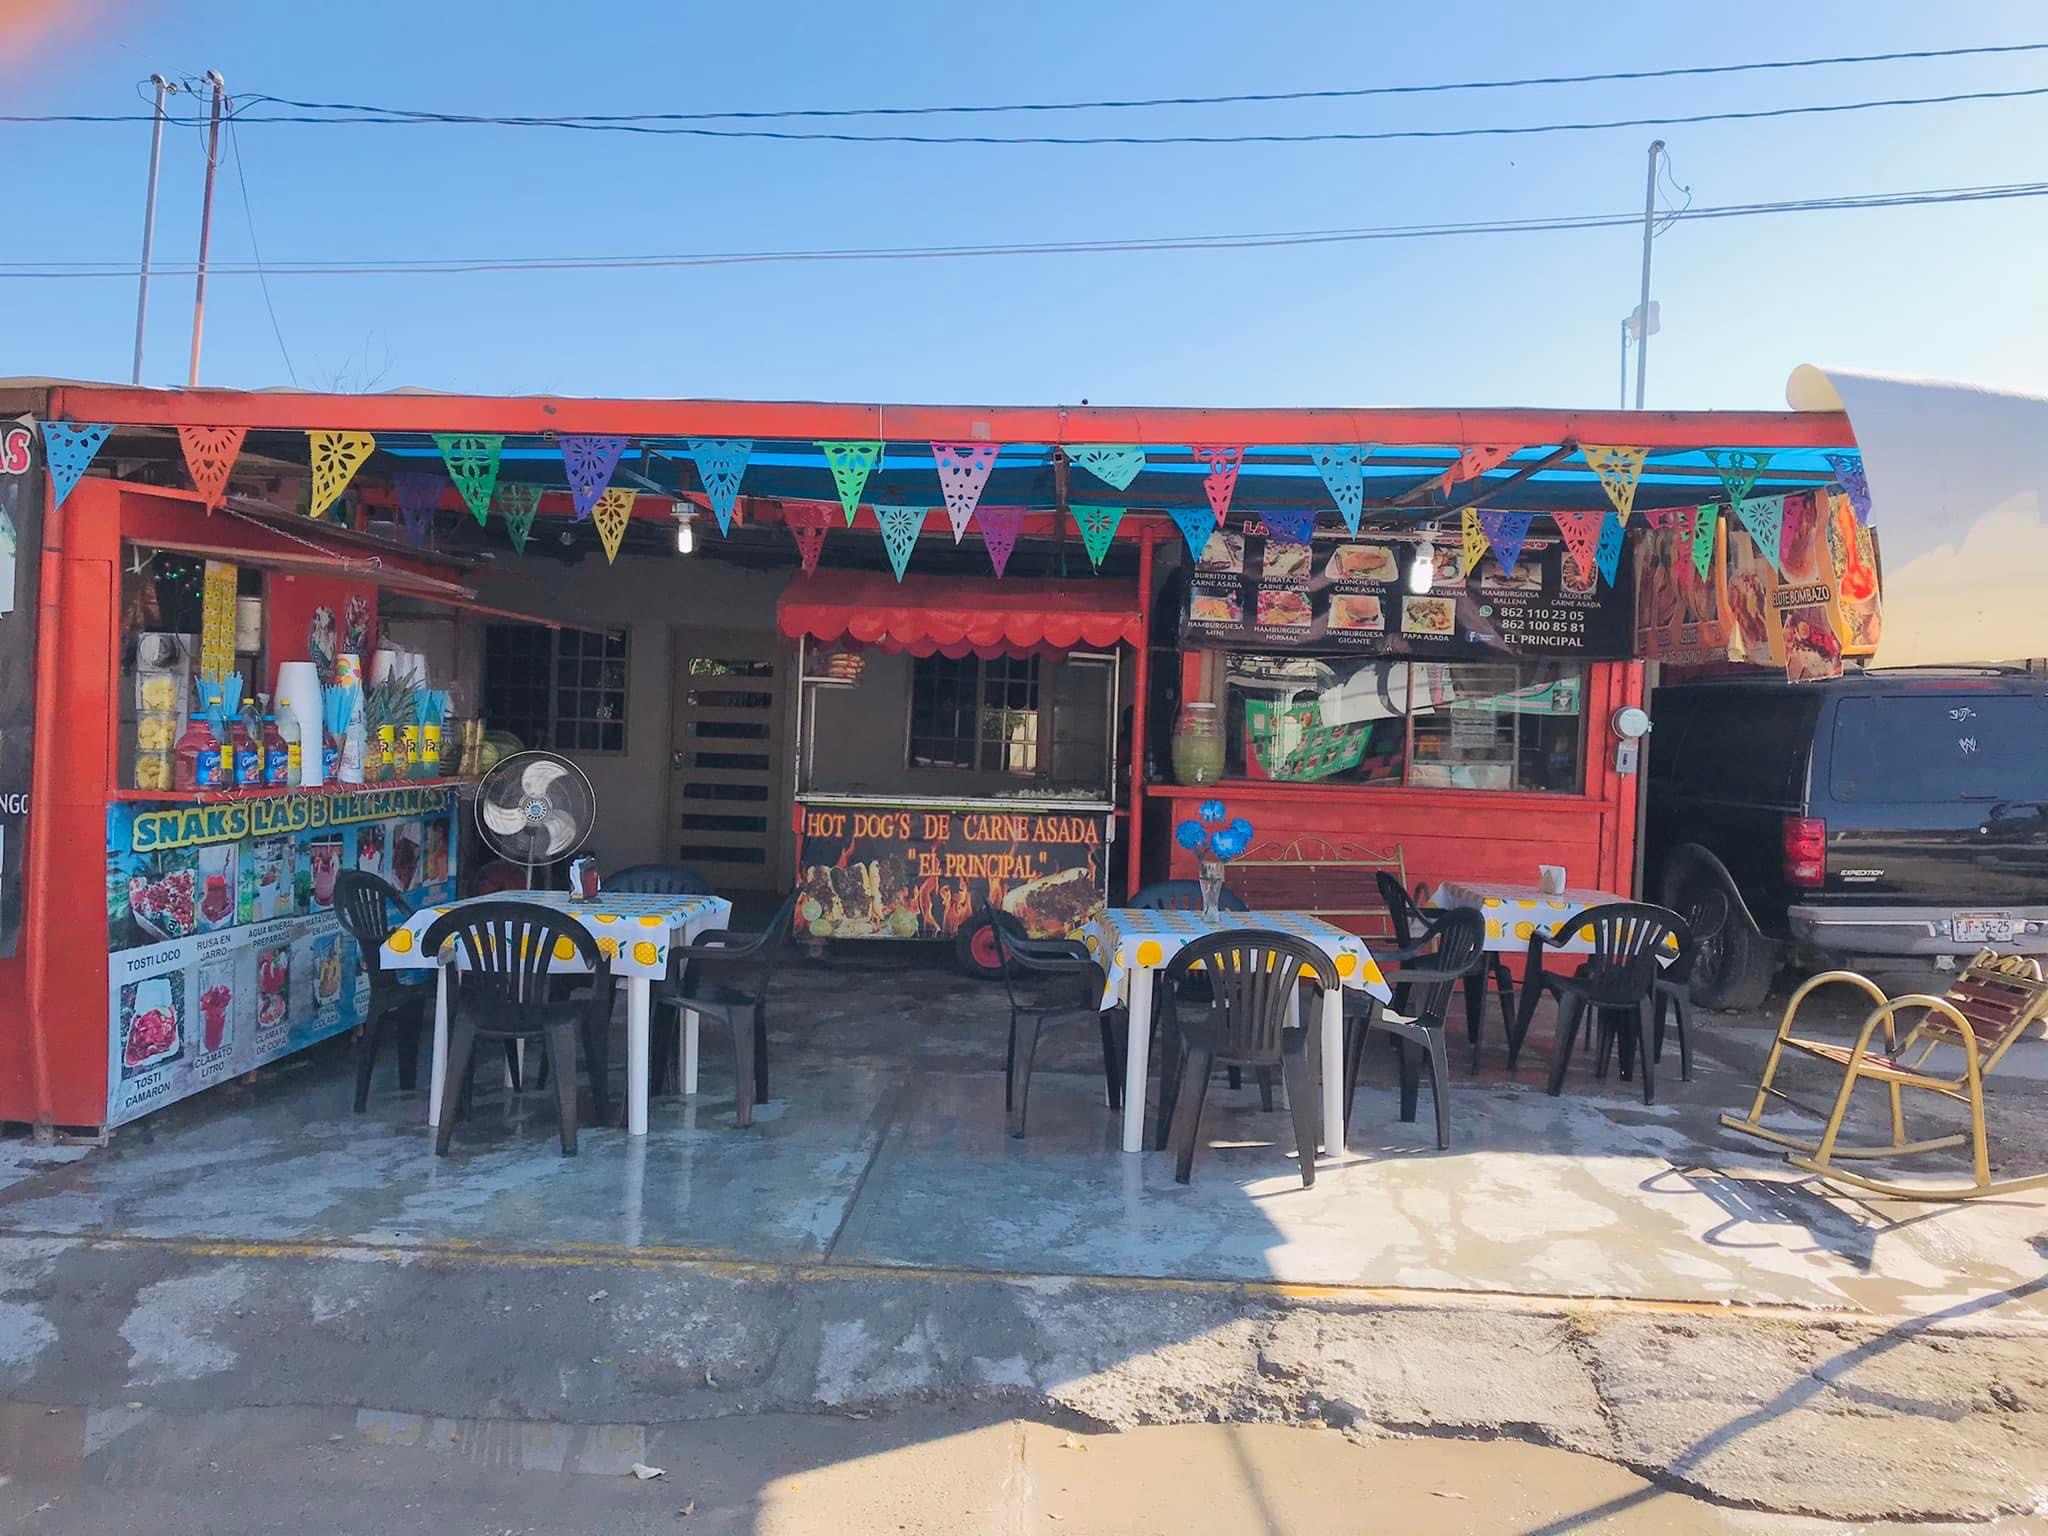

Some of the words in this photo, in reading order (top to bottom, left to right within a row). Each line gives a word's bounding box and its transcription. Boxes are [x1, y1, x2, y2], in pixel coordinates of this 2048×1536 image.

[1243, 520, 1270, 536] LA
[1194, 572, 1227, 581] BURRITO
[1264, 576, 1291, 584] PIRATA
[1191, 580, 1218, 588] CARNE
[1219, 581, 1242, 589] ASADA
[1258, 583, 1284, 591] CARNE
[1285, 584, 1310, 592] ASADA
[1339, 578, 1369, 587] LONCHE
[1334, 585, 1361, 594] CARNE
[1362, 586, 1386, 595] ASADA
[1435, 589, 1468, 598] CUBANA
[1482, 590, 1540, 599] HAMBURGUESA
[1790, 586, 1830, 604] BOMBAZO
[1559, 592, 1582, 600] TACOS
[1493, 598, 1528, 606] BALLENA
[1551, 599, 1575, 607] CARNE
[1576, 601, 1602, 609] ASADA
[1500, 607, 1524, 618] 862
[1527, 608, 1549, 619] 110
[1551, 609, 1567, 620] 23
[1569, 611, 1585, 621] 05
[1187, 621, 1245, 631] HAMBURGUESA
[1254, 626, 1311, 635] HAMBURGUESA
[1501, 619, 1525, 630] 862
[1528, 620, 1550, 631] 100
[1552, 621, 1568, 632] 85
[1570, 623, 1585, 633] 81
[1206, 629, 1225, 637] MINI
[1266, 632, 1298, 641] NORMAL
[1326, 629, 1384, 639] HAMBURGUESA
[1402, 632, 1422, 640] PAPA
[1423, 633, 1450, 642] ASADA
[1338, 637, 1371, 646] GIGANTE
[1504, 633, 1518, 645] EL
[1520, 635, 1584, 648] PRINCIPAL
[133, 804, 250, 852] SNAKS
[251, 797, 309, 837] LAS
[310, 796, 329, 829] 3
[806, 812, 846, 838] HOT
[854, 811, 911, 840] DOG'S
[923, 814, 950, 841] DE
[963, 814, 1029, 842] CARNE
[1032, 816, 1099, 844] ASADA
[1840, 869, 1885, 877] EXPEDITION
[248, 926, 267, 939] AGUA
[267, 919, 293, 934] MINERAL
[197, 938, 219, 951] RUSA
[219, 934, 231, 946] EN
[127, 952, 156, 972] TOSTI
[156, 948, 181, 968] LOCO
[200, 948, 227, 962] JARRO
[256, 1025, 289, 1044] CLAMATO
[256, 1044, 267, 1056] DE
[267, 1038, 287, 1051] COPA
[194, 1047, 233, 1069] CLAMATO
[201, 1061, 225, 1078] LITRO
[134, 1072, 162, 1090] TOSTI
[125, 1082, 171, 1108] CAMARON
